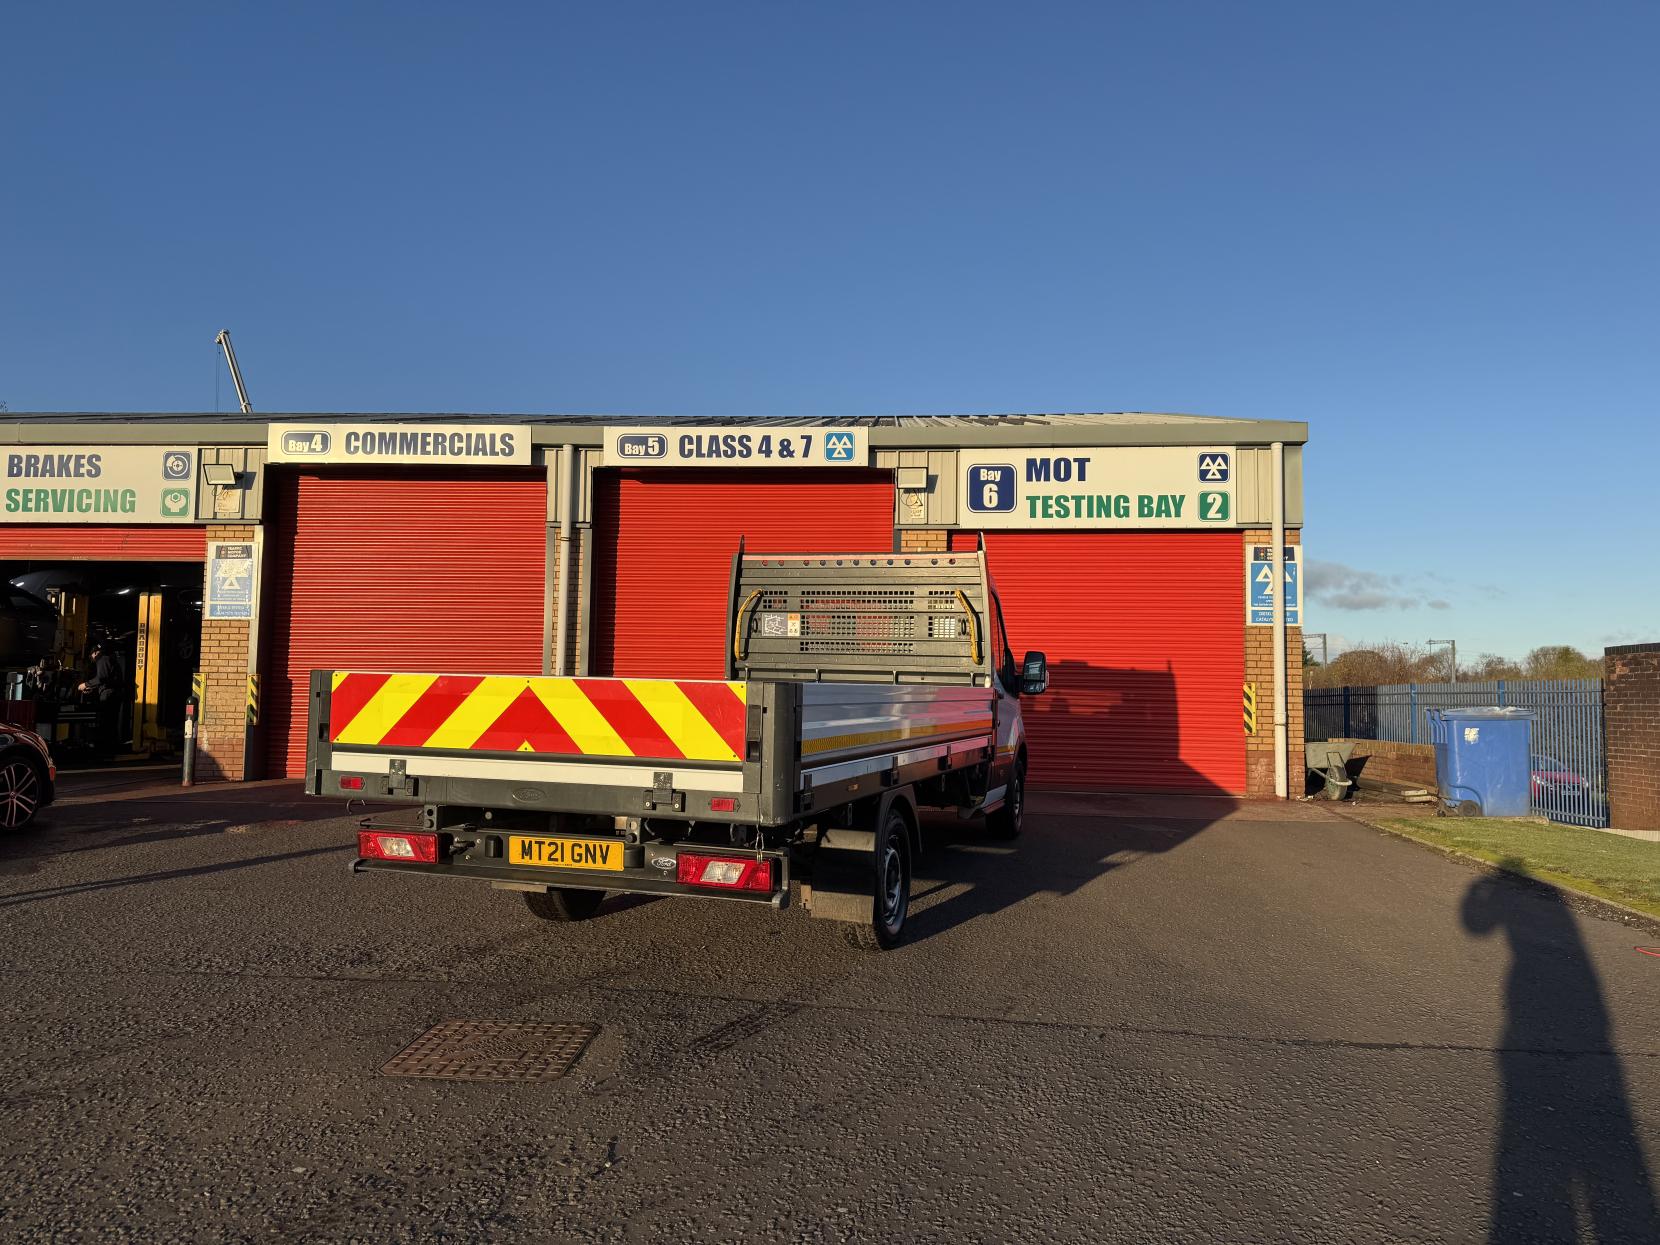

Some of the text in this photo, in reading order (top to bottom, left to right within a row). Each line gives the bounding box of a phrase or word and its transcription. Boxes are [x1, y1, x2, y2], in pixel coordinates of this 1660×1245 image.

[288, 434, 323, 452] Bay 4
[345, 431, 515, 457] COMMERCIALS
[624, 437, 659, 456] Bay 5
[678, 434, 813, 459] CLASS 4 & 7
[7, 453, 102, 478] BRAKES
[979, 468, 1001, 482] Bay
[1025, 457, 1091, 482] MOT
[5, 488, 137, 513] SERVICING
[983, 483, 998, 508] 6
[1025, 494, 1186, 519] TESTING BAY
[1206, 493, 1223, 519] 2
[137, 623, 146, 670] BRADBURY
[521, 840, 610, 864] MT21 GNV
[655, 858, 672, 867] Ford
